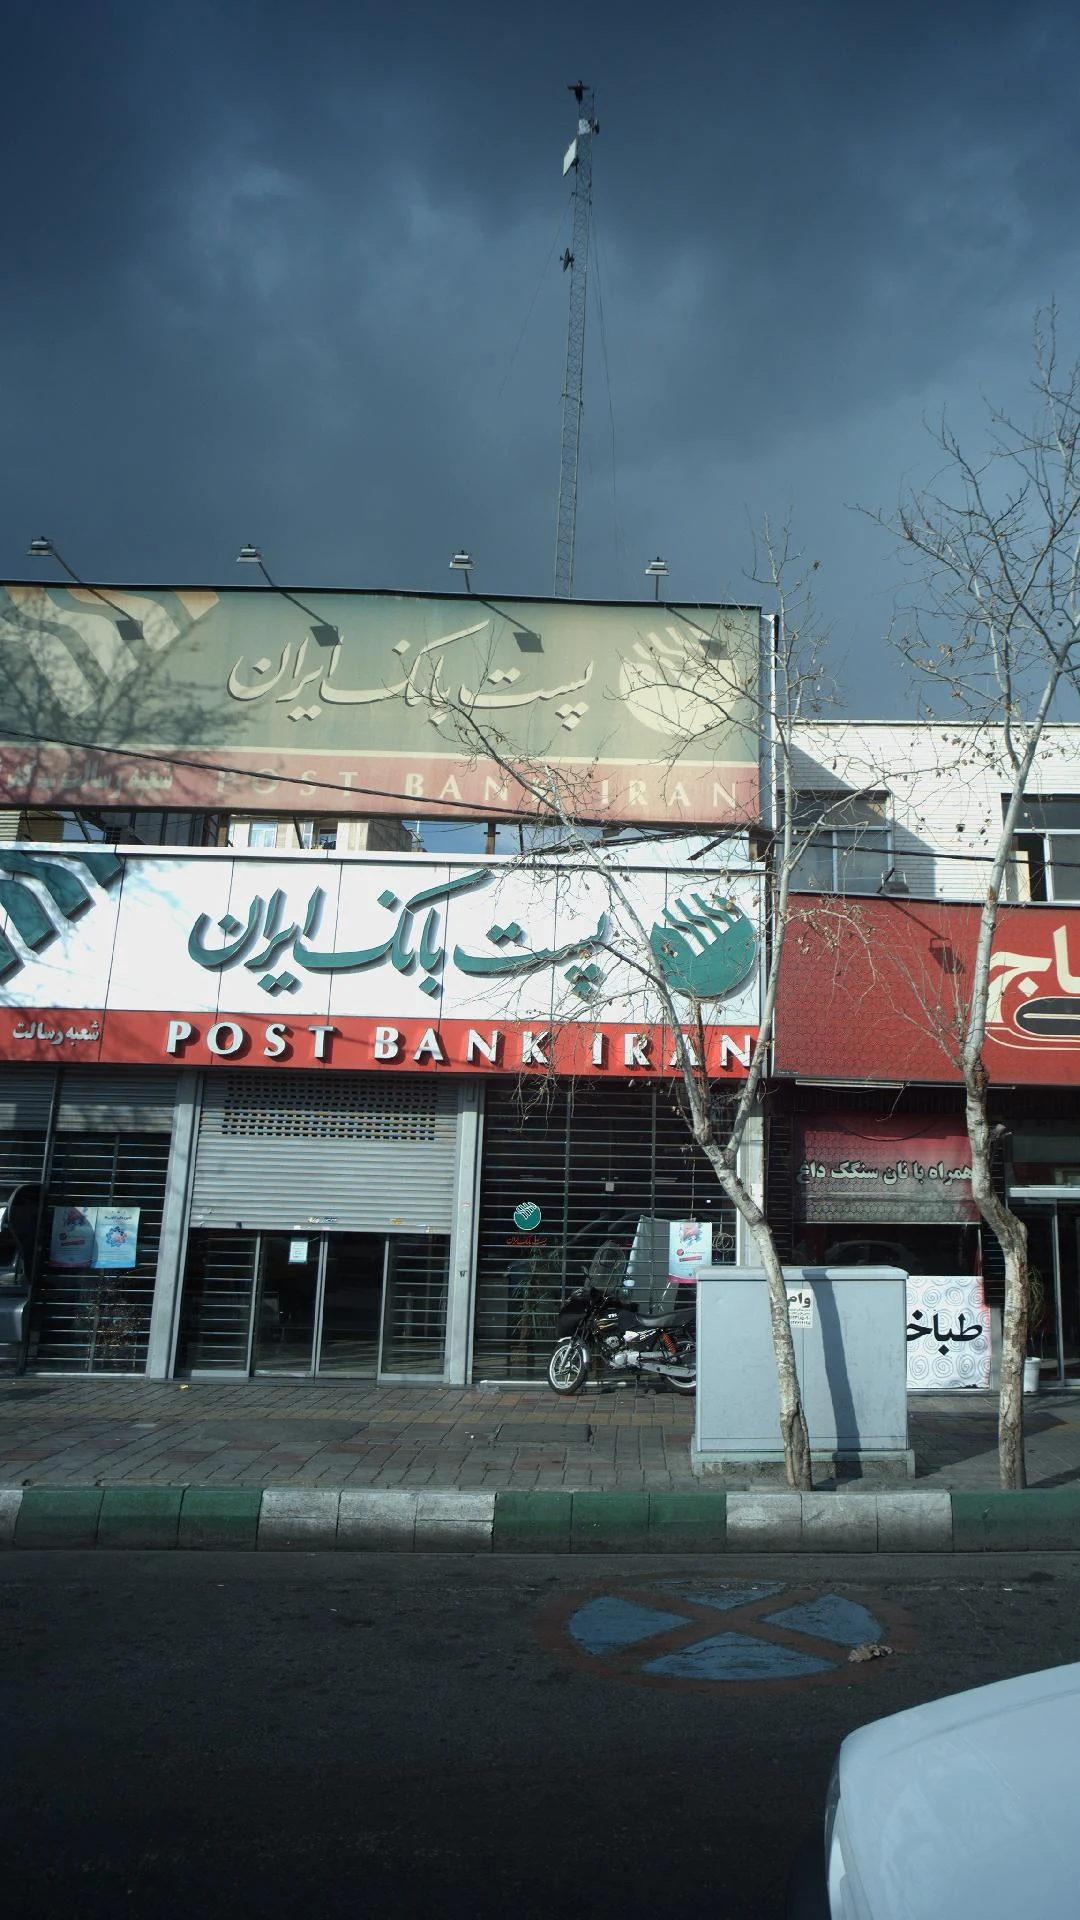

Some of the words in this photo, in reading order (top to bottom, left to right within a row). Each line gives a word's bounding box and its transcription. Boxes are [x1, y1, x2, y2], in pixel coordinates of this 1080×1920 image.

[227, 635, 344, 722] ایران
[319, 619, 490, 727] بانک
[458, 659, 594, 732] پست
[216, 767, 359, 797] POST
[601, 778, 737, 809] IRAN
[188, 886, 324, 996] ایران
[293, 868, 492, 998] بانک
[453, 911, 609, 1000] پست
[12, 1021, 64, 1045] رسالت
[65, 1020, 99, 1046] شعبه
[165, 1020, 336, 1059] POST
[373, 1026, 550, 1065] BANK
[592, 1032, 752, 1067] IRAN
[830, 1160, 879, 1180] سنگک
[883, 1160, 909, 1186] نان
[912, 1161, 924, 1184] با
[928, 1161, 973, 1186] همراه
[787, 1292, 811, 1309] وام
[906, 1309, 983, 1356] طباخ
